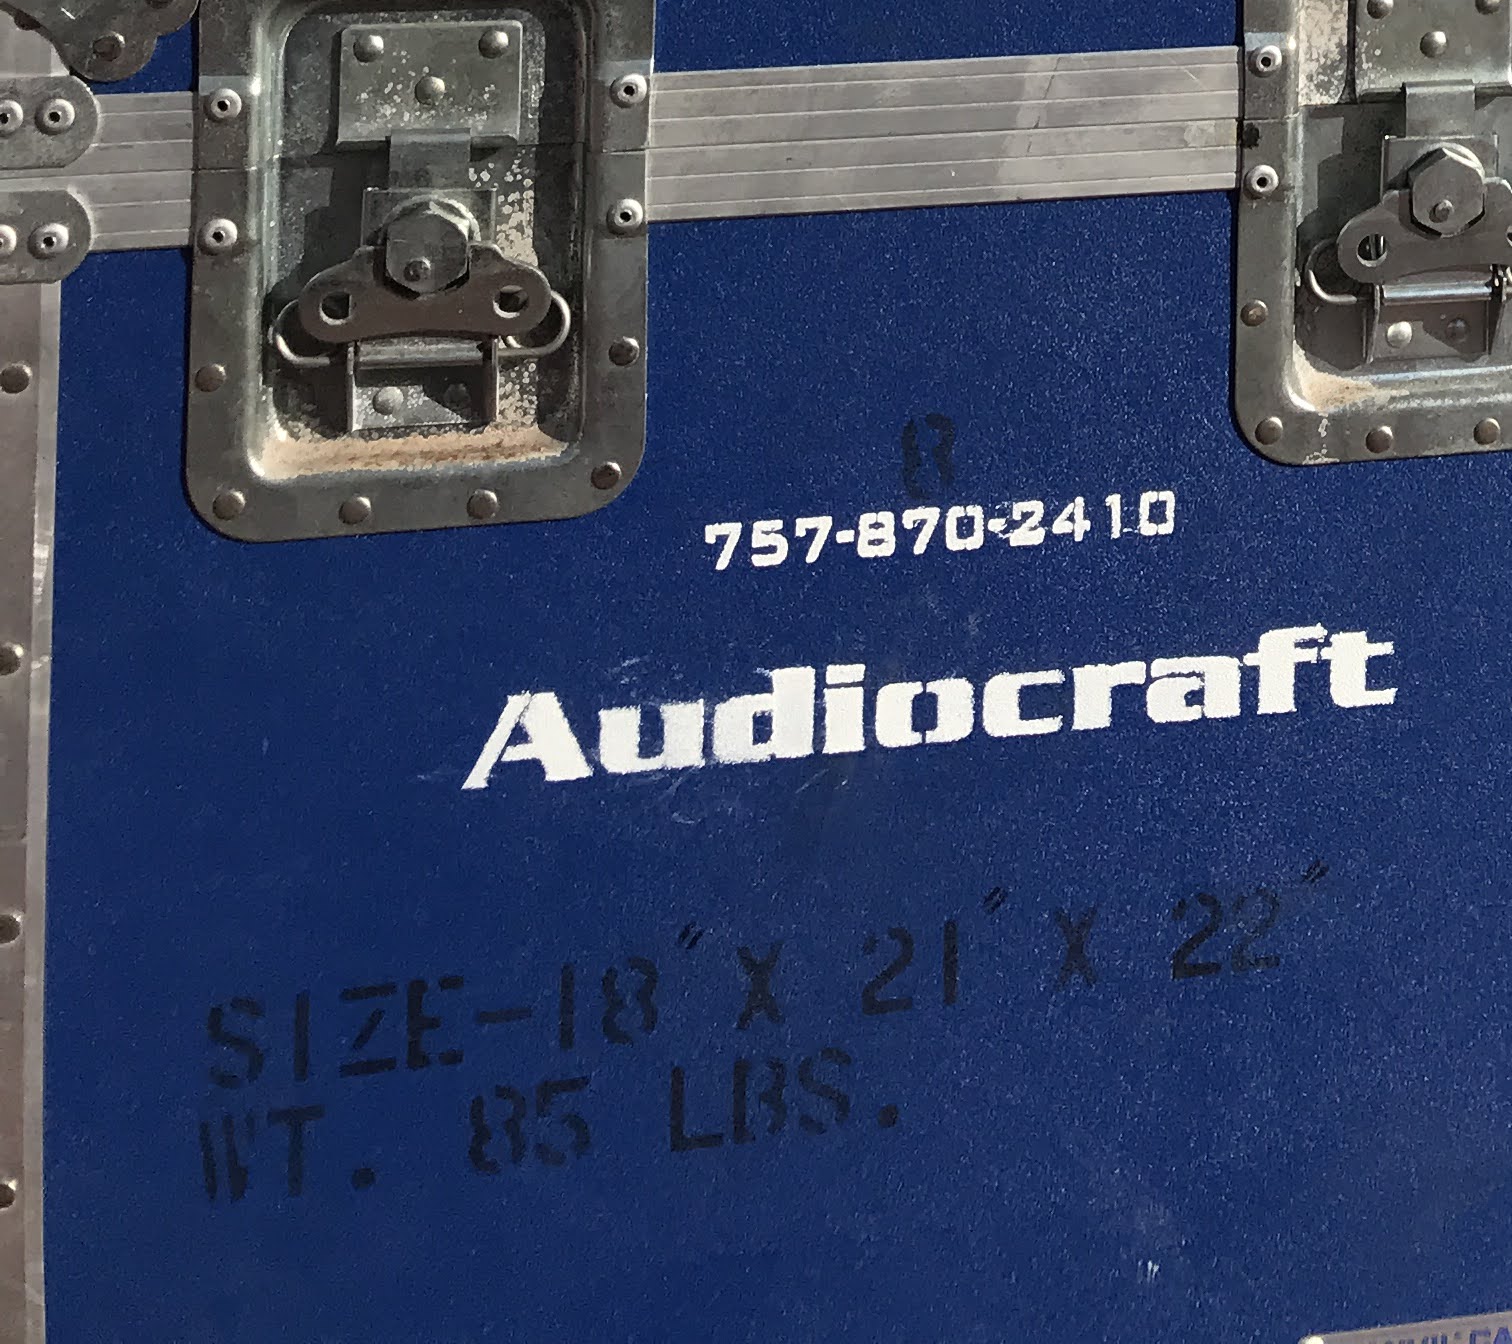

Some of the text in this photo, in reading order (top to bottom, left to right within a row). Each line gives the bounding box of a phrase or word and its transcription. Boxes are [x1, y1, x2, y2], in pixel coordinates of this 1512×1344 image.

[703, 490, 1176, 571] 757-870-2410
[461, 621, 1399, 790] Audiocraft
[738, 943, 785, 1034] X
[1050, 905, 1099, 990] X
[199, 1104, 379, 1205] WT.
[669, 1046, 904, 1154] LBS.
